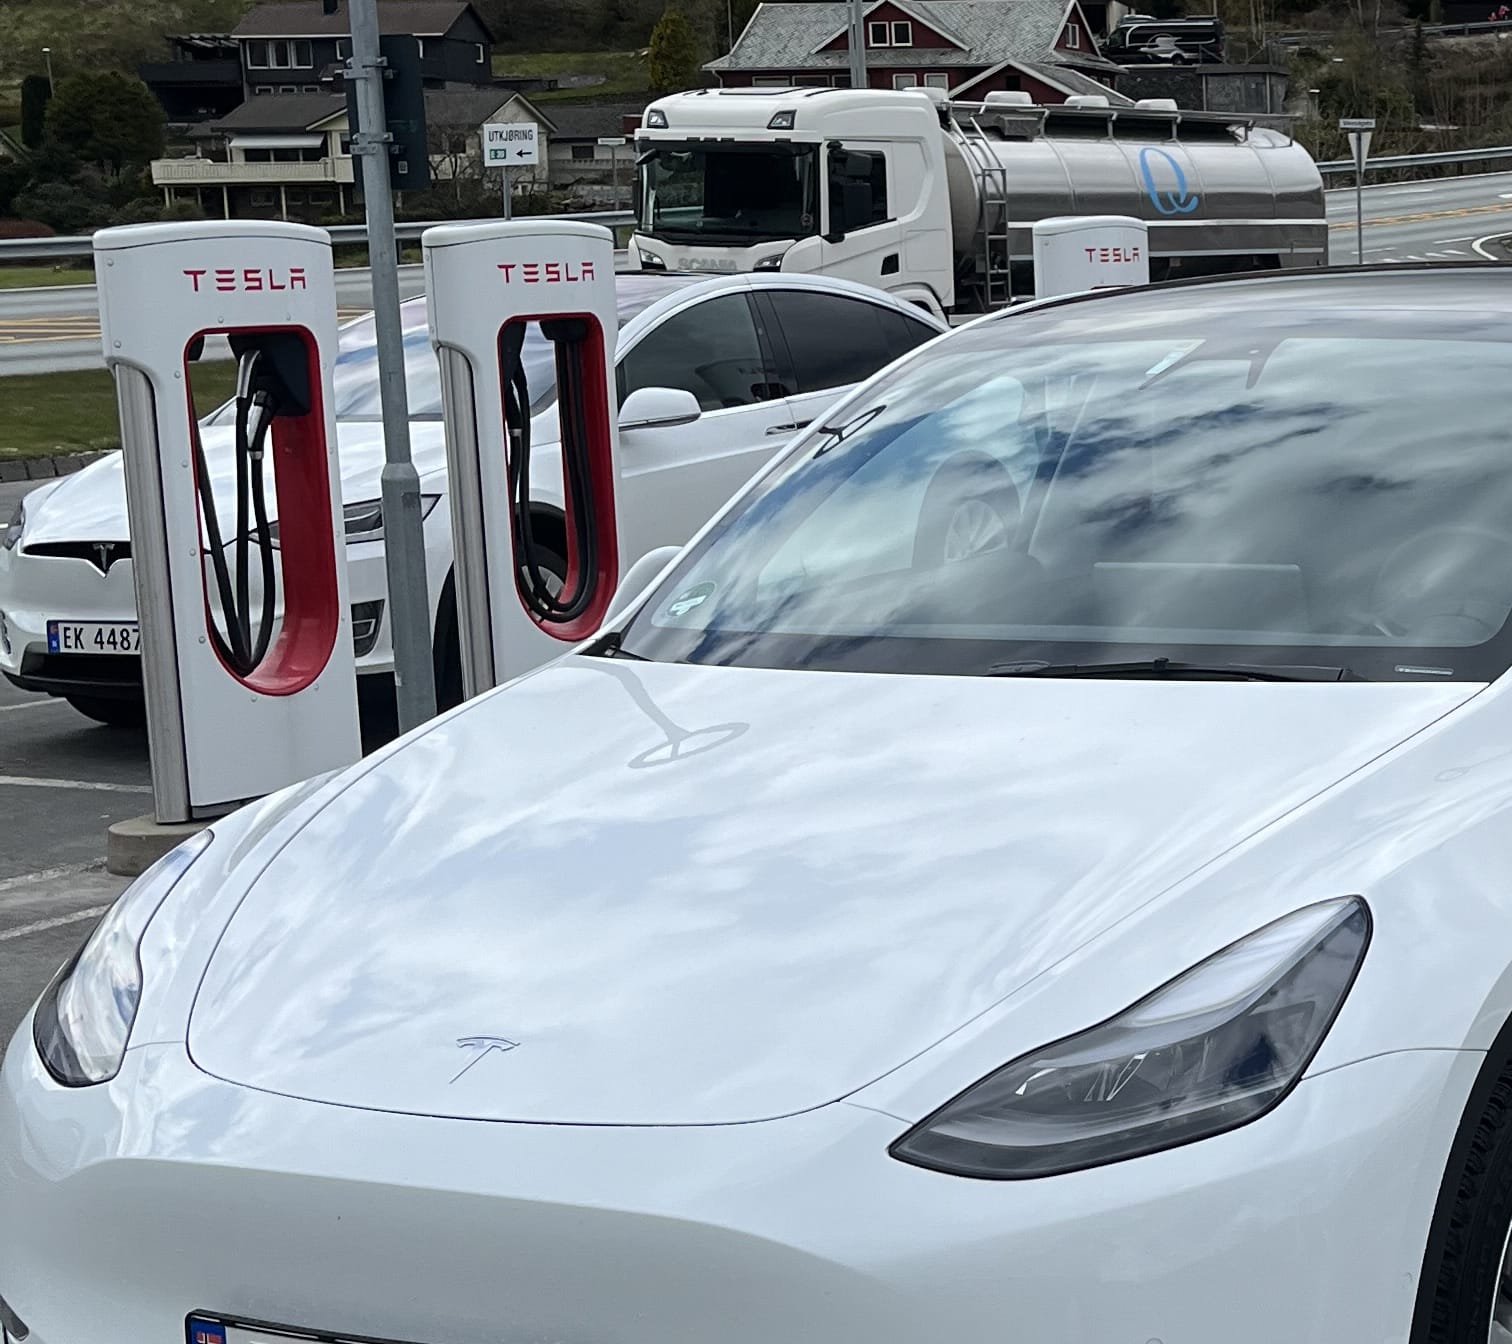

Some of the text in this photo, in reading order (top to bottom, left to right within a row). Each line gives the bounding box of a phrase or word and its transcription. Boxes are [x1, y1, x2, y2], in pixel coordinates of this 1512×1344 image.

[488, 129, 534, 142] UTKJØRING
[1085, 247, 1139, 263] TESLA
[183, 268, 306, 292] TESLA
[497, 262, 595, 284] TESLA
[63, 626, 140, 651] EK 4487
